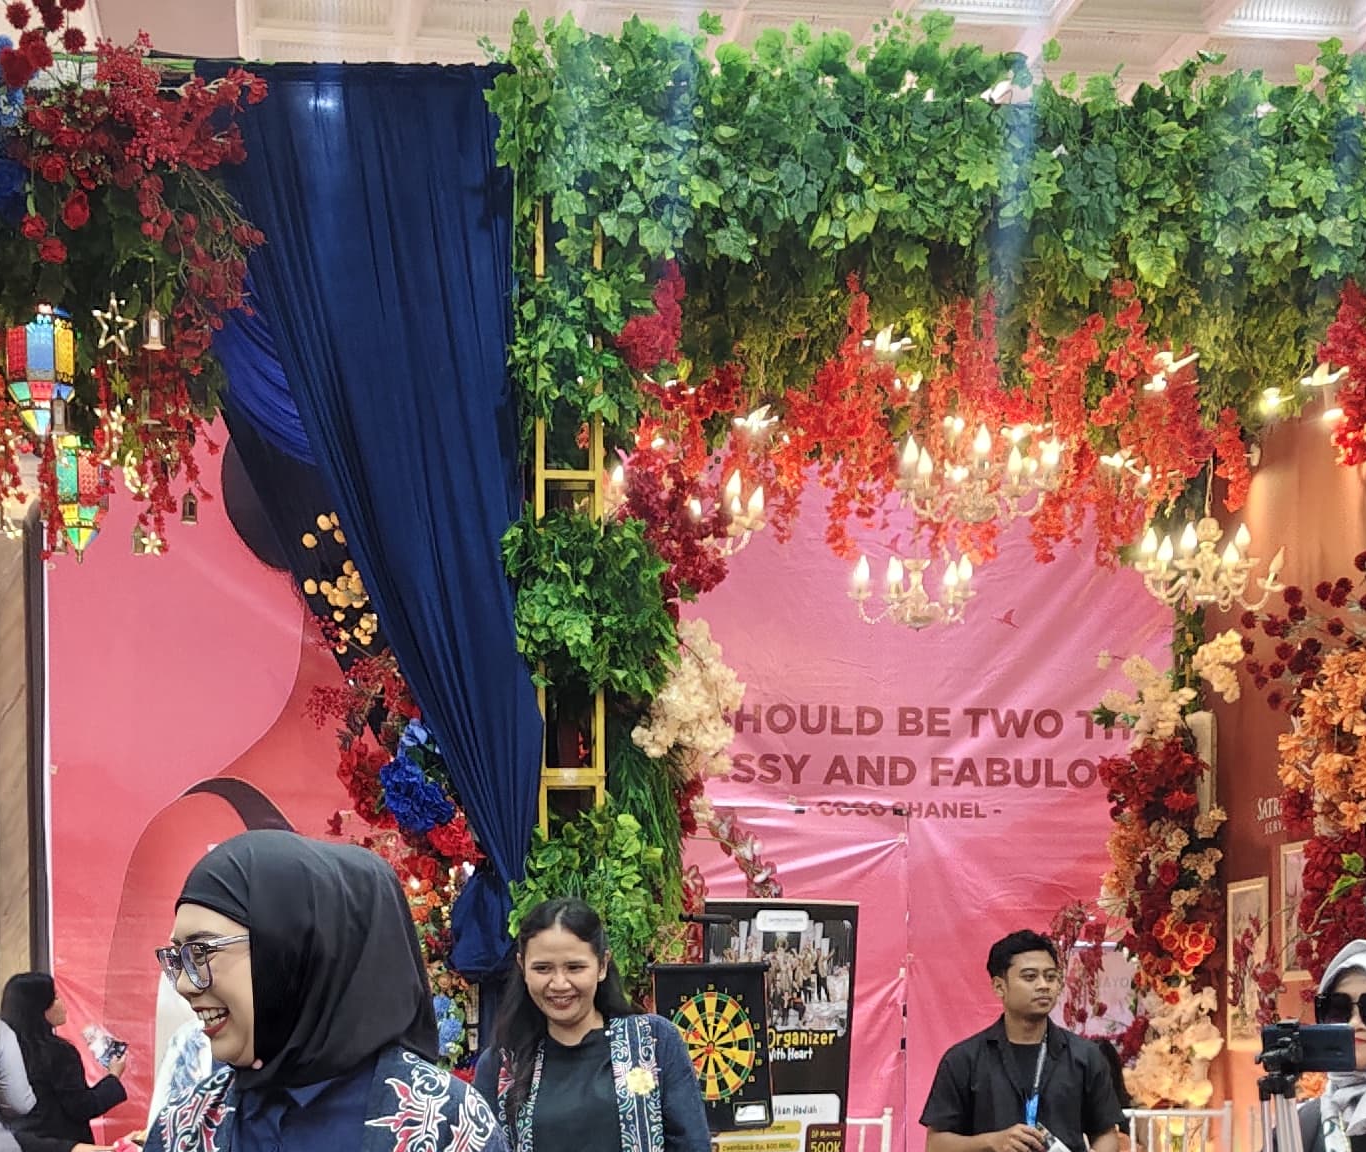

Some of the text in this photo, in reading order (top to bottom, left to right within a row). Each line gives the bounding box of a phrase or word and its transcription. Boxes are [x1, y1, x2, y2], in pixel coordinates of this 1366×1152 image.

[723, 703, 884, 736] HOULD
[897, 706, 951, 737] BE
[963, 708, 1064, 739] TWO
[719, 753, 1110, 788] SSY AND FABULO
[817, 801, 886, 817] COCO
[787, 1046, 813, 1062] Heart
